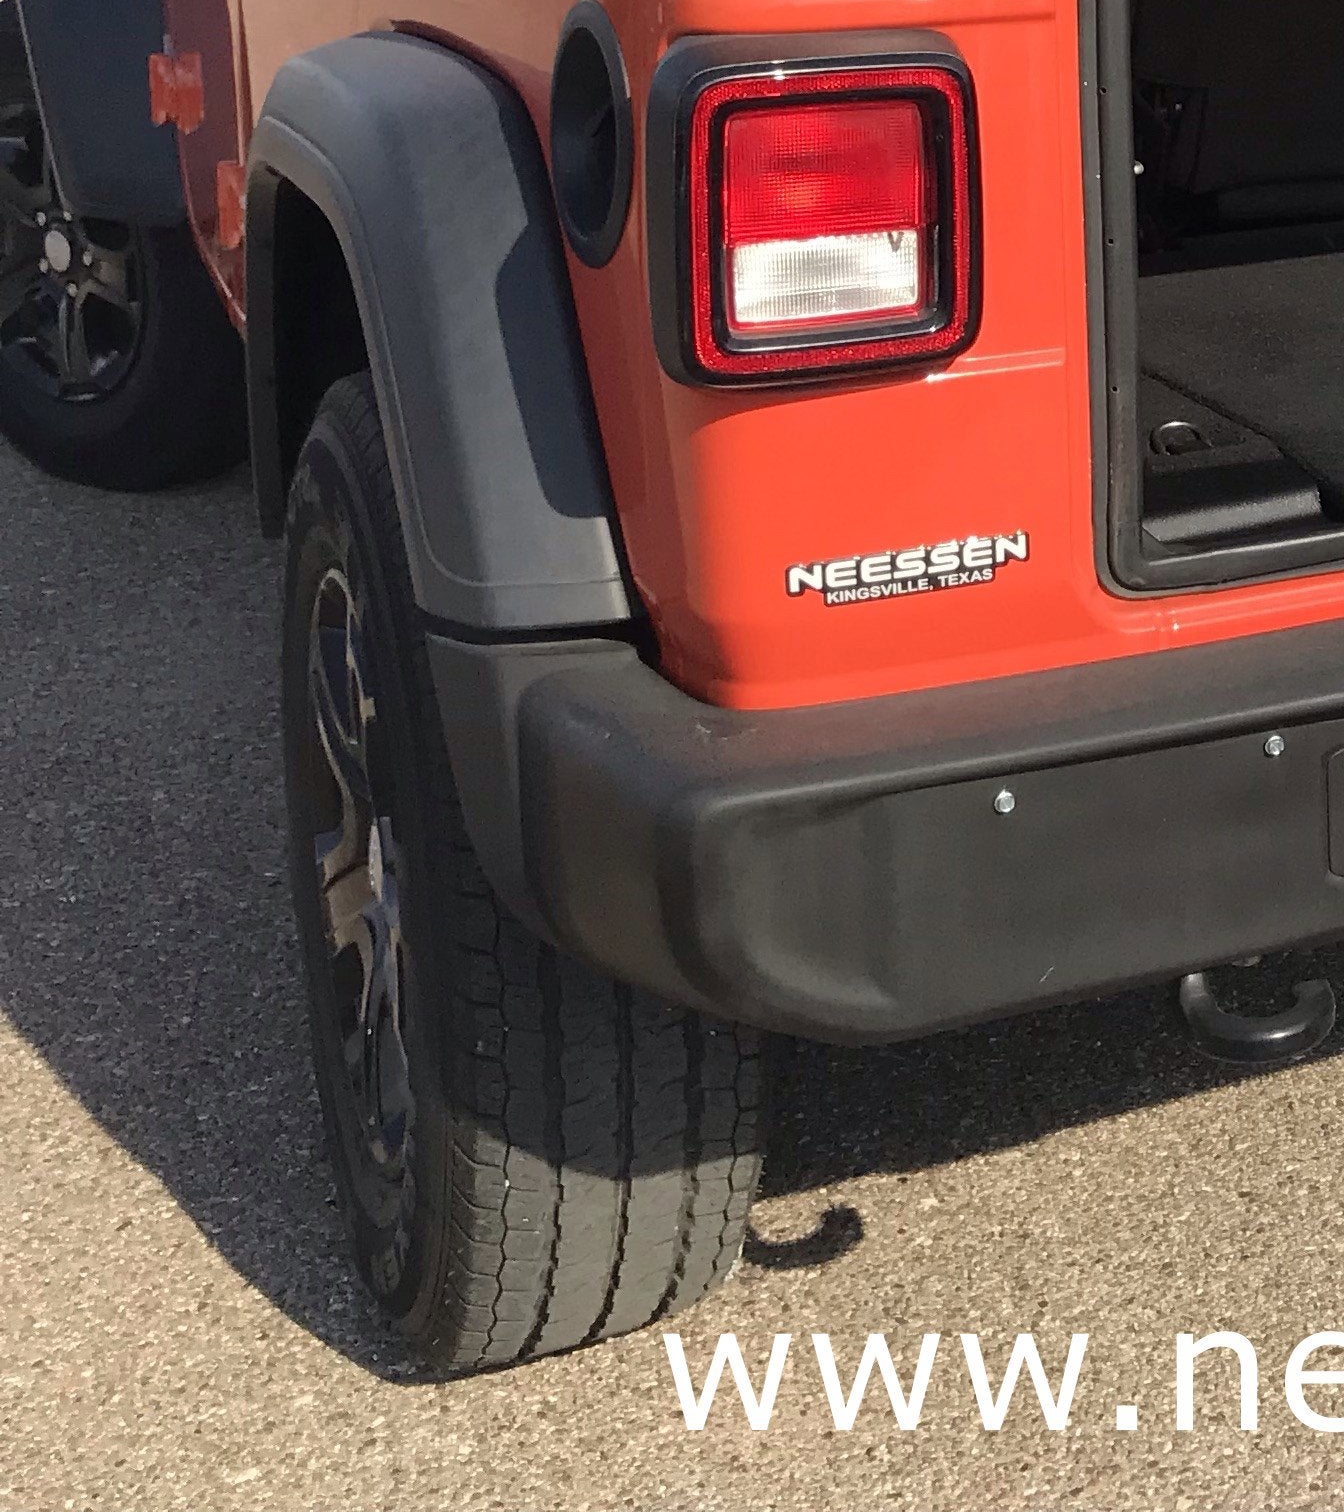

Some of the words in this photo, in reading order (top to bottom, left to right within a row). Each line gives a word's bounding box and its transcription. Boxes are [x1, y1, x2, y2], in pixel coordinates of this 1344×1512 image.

[788, 531, 1028, 594] NEESSEN
[826, 577, 934, 605] KINGSVILLE,
[937, 568, 994, 588] TEXAS
